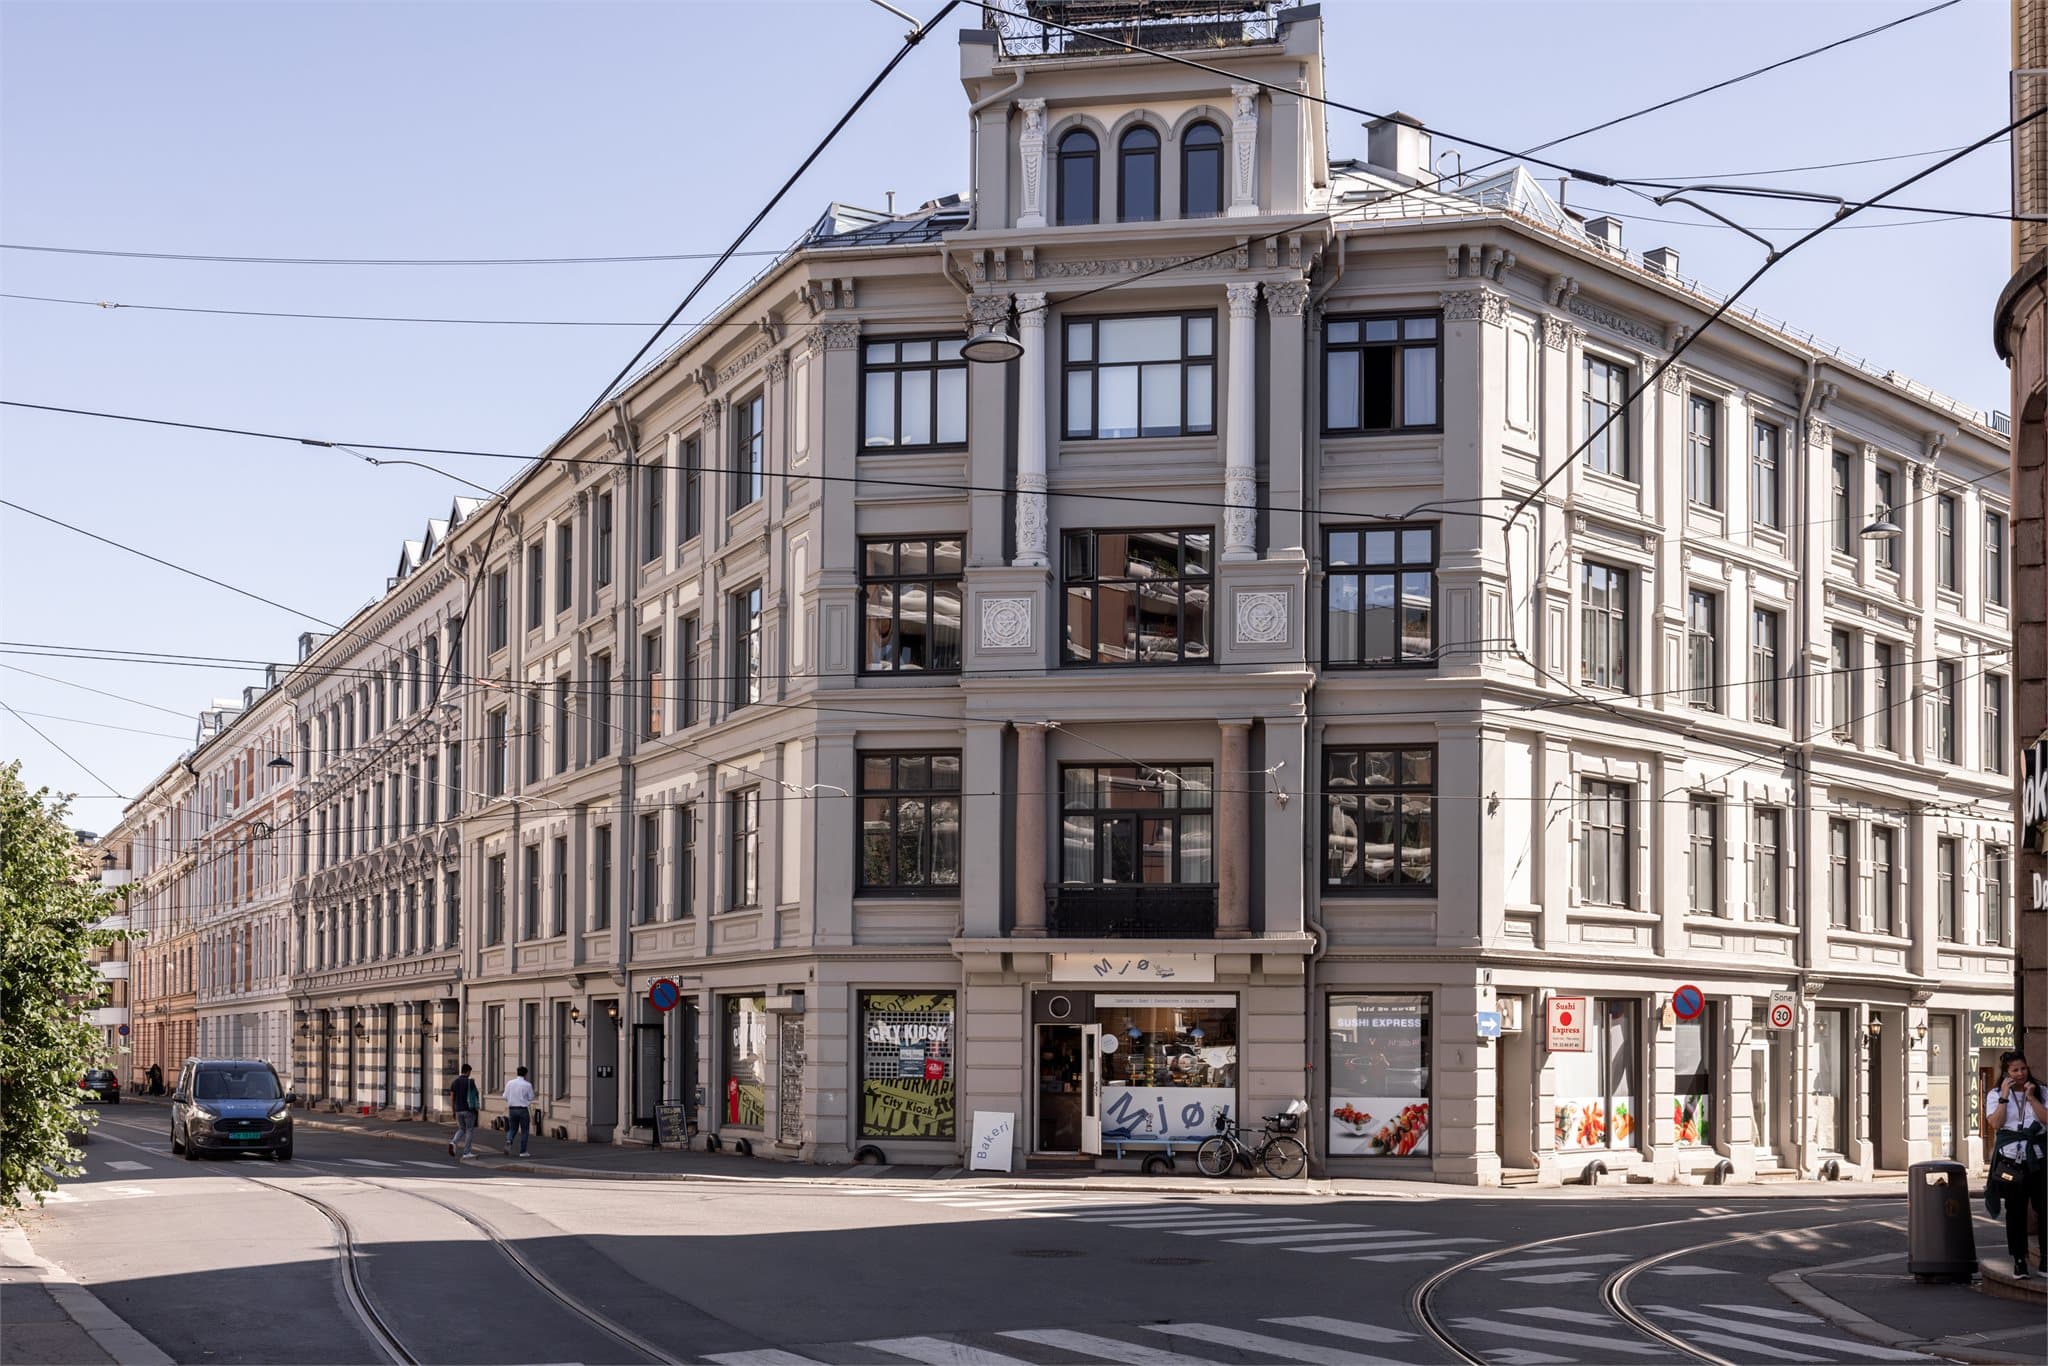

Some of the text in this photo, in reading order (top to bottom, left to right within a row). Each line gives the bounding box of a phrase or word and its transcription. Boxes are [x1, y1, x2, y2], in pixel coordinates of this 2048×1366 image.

[1774, 993, 1792, 1001] Sone
[1776, 1011, 1789, 1021] 30
[1337, 1018, 1421, 1028] SUSHI EXPRESS
[904, 1024, 947, 1046] KIOSK
[1552, 1026, 1580, 1035] Express
[882, 1095, 904, 1110] City
[905, 1100, 934, 1117] Kiosk
[976, 1121, 1009, 1159] Bakeri
